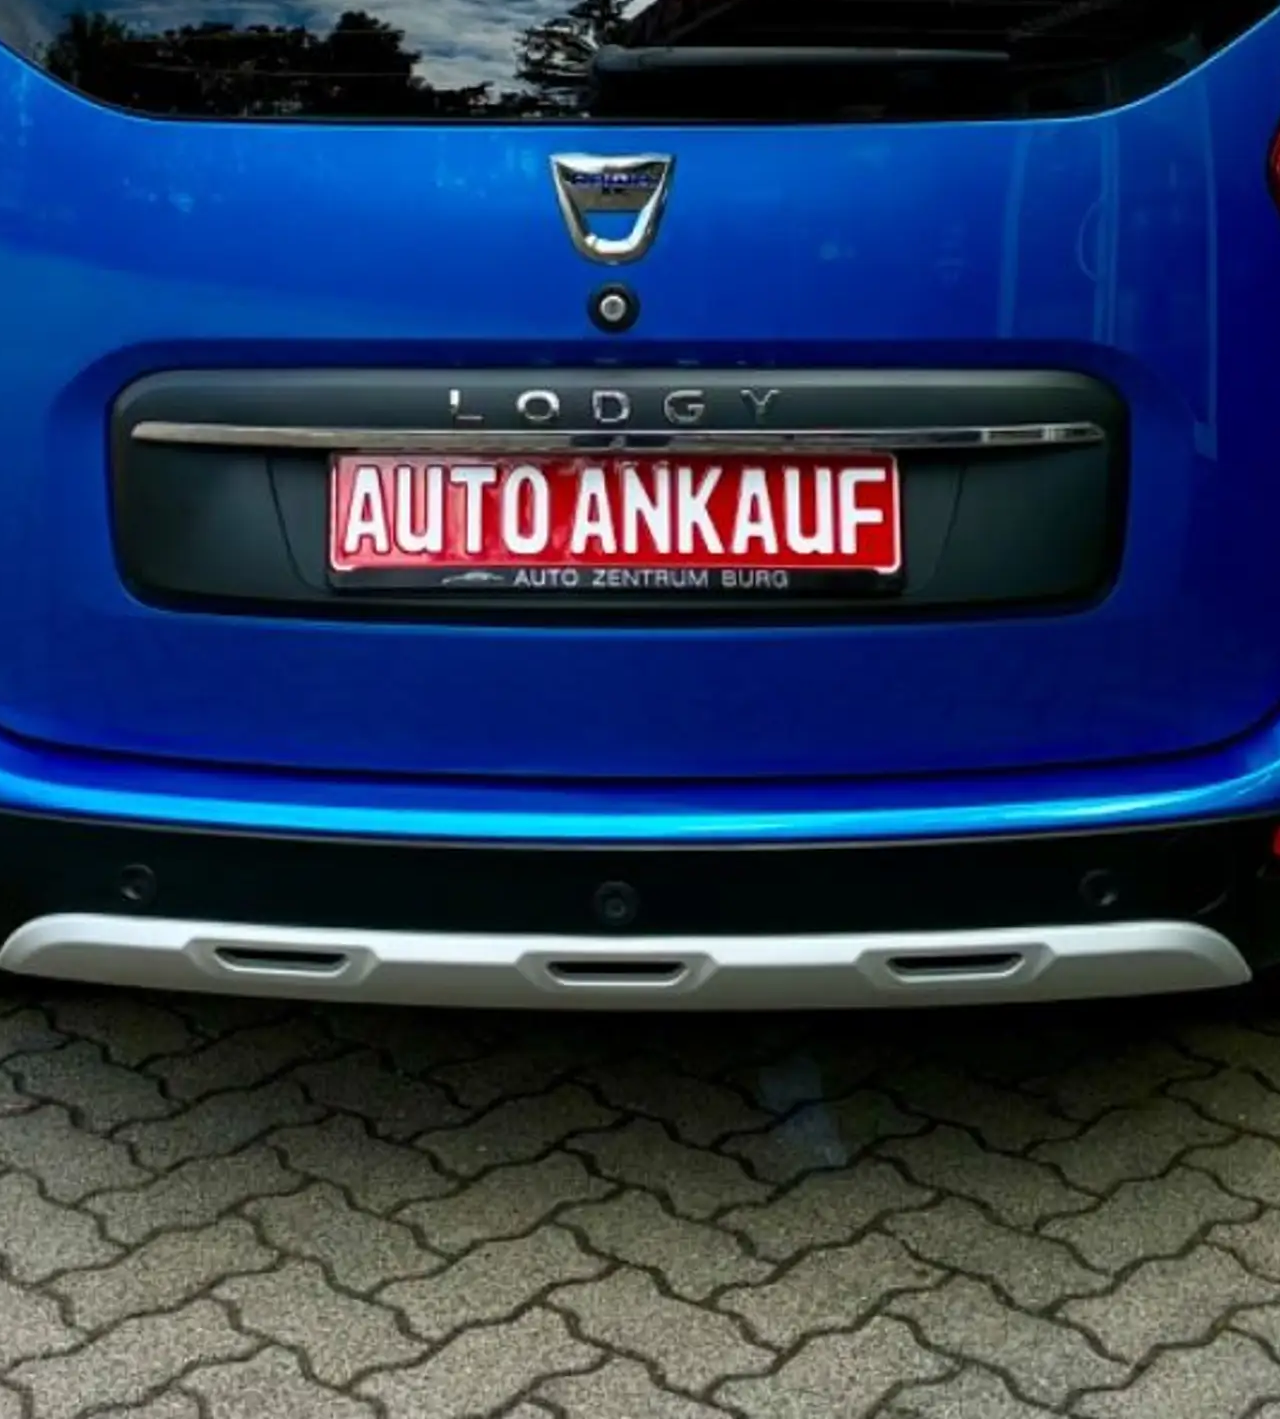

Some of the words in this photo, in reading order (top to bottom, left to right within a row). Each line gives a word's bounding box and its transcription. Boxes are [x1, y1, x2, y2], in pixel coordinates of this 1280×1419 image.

[449, 388, 780, 423] LODGY
[343, 464, 551, 555] AUTO
[570, 466, 888, 555] ANKAUF
[513, 569, 580, 589] AUTO
[591, 569, 710, 589] ZENTRUM
[721, 569, 789, 589] BURG
